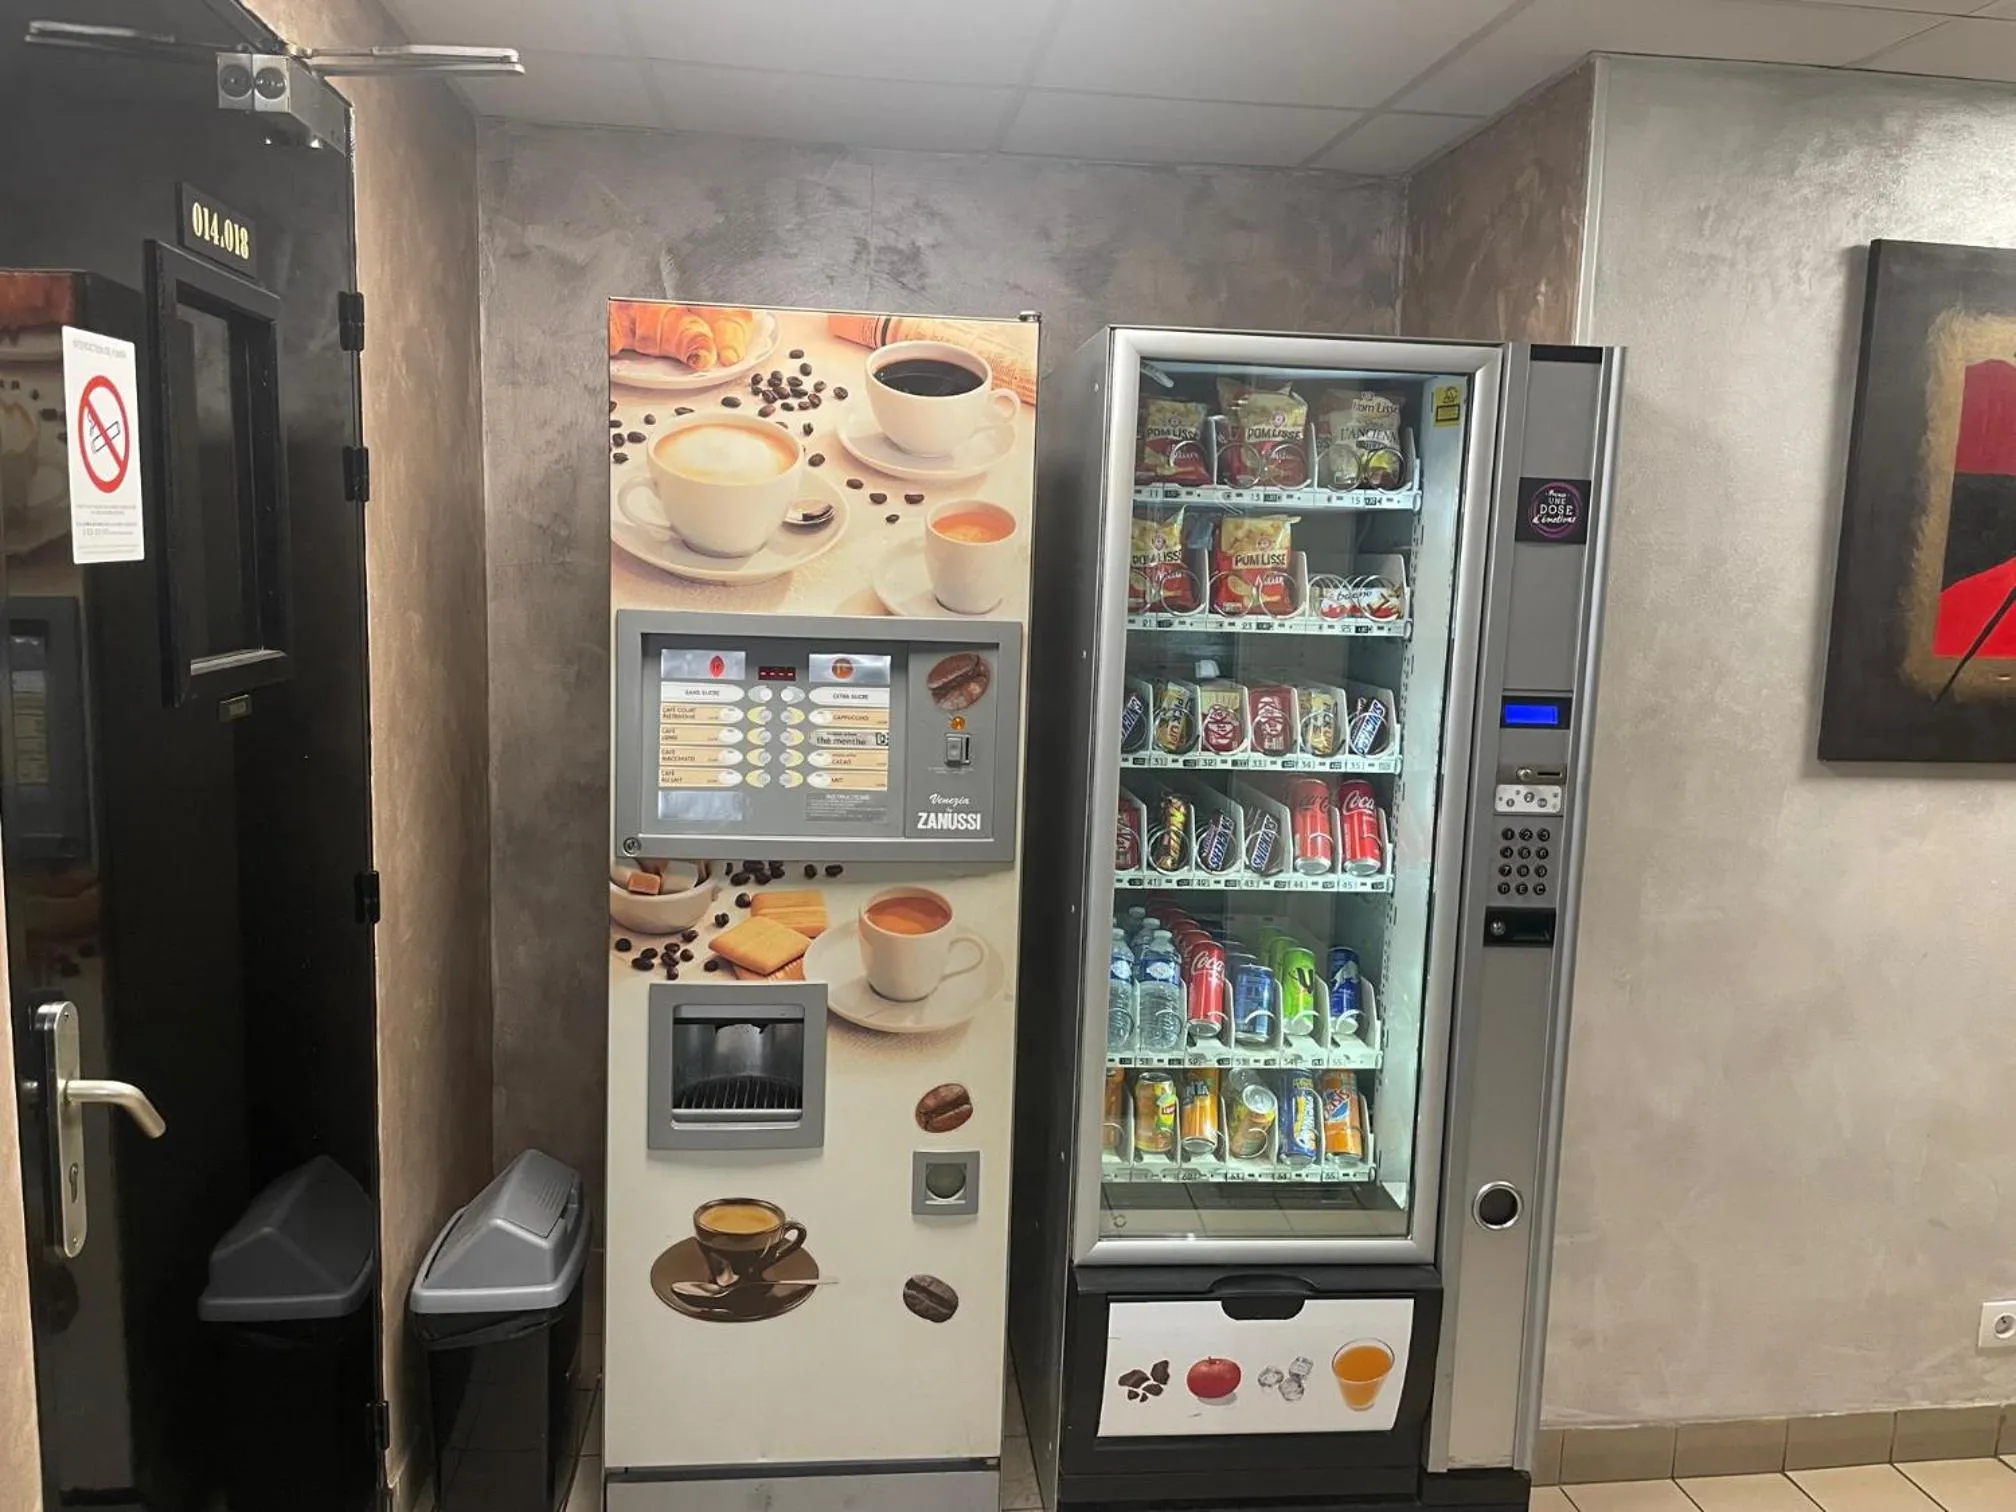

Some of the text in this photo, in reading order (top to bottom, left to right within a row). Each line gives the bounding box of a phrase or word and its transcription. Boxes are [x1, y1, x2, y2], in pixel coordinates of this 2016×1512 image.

[192, 202, 249, 260] 014.018
[1540, 503, 1574, 516] DOSE
[1548, 497, 1567, 505] UNE
[929, 793, 970, 808] Venezia
[1342, 789, 1376, 816] Coca
[917, 812, 981, 831] ZANUSSI
